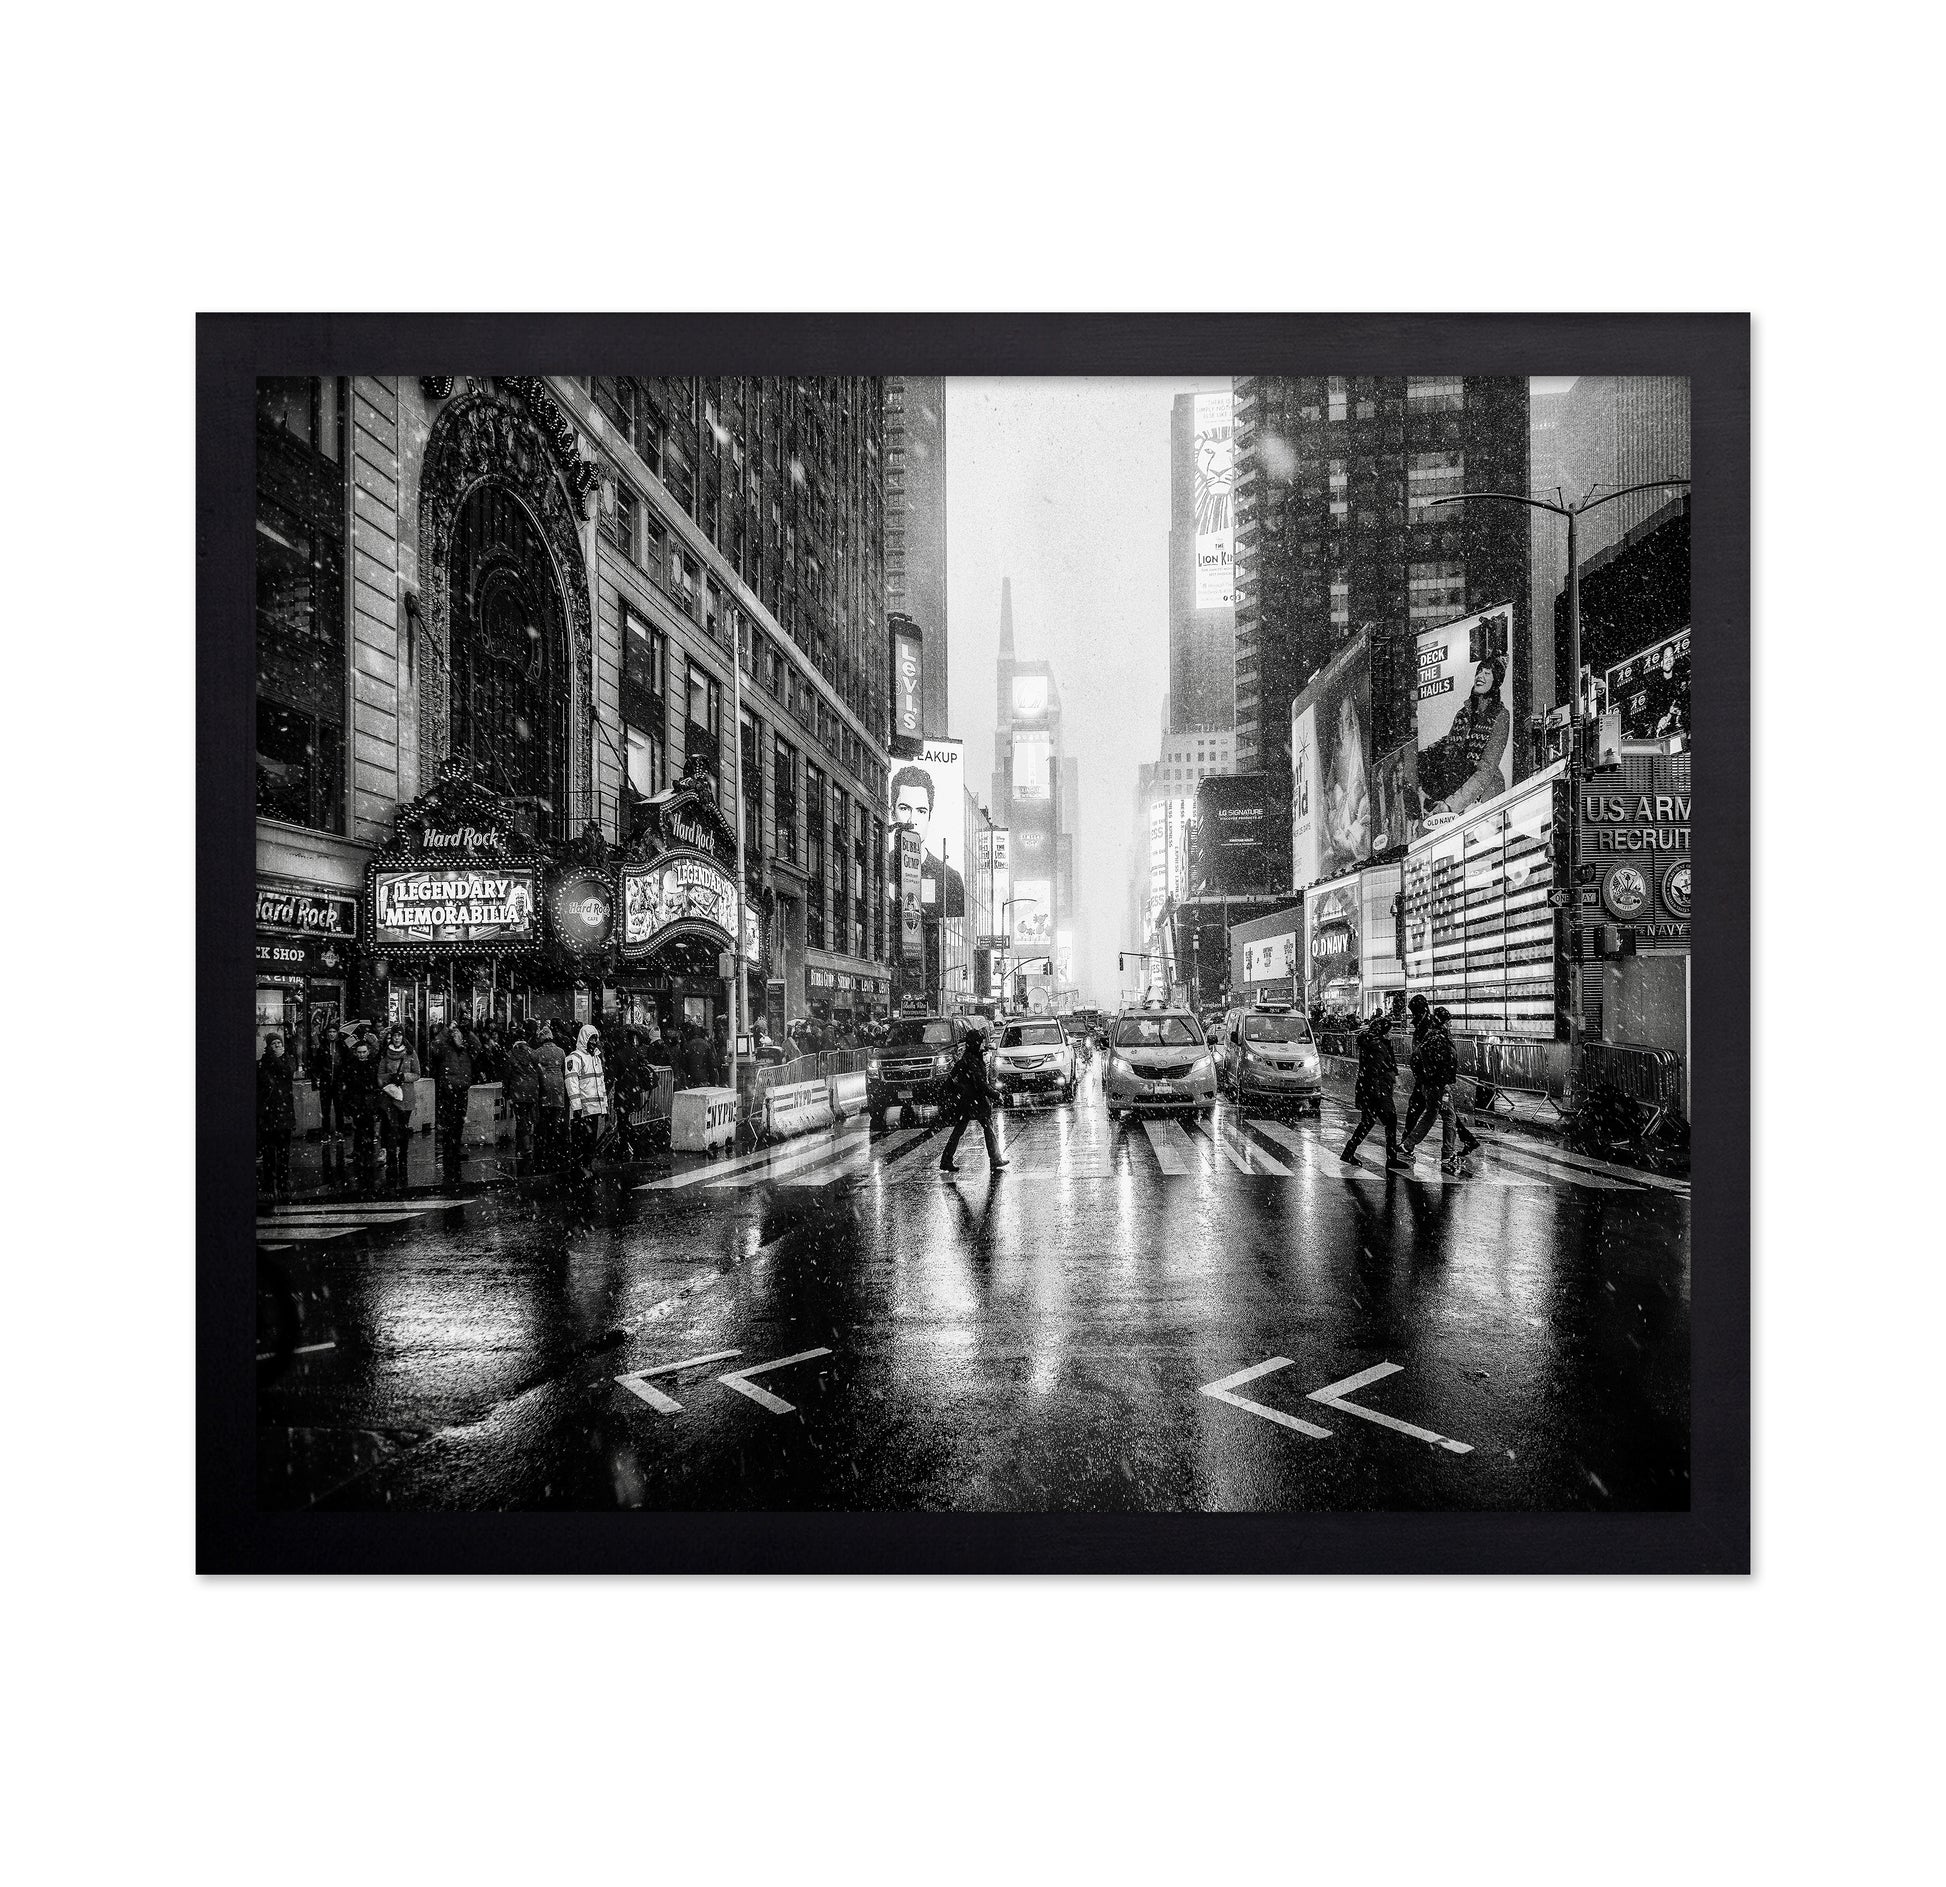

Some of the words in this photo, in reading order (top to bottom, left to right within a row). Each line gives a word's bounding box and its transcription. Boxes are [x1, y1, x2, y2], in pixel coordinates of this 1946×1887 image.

[1198, 553, 1219, 567] LION
[1420, 648, 1446, 667] DECK
[1420, 667, 1438, 682] THE
[1420, 680, 1450, 699] HAULS
[1427, 818, 1439, 827] OLD
[1439, 815, 1456, 825] NAVY
[423, 827, 463, 847] Hard
[463, 827, 499, 850] Rock
[673, 813, 696, 843] Hard
[697, 824, 715, 855] Rock
[903, 854, 920, 870] GUMP
[397, 879, 509, 901] LEGENDARY
[1556, 894, 1569, 903] ONE
[297, 898, 338, 932] Rock
[385, 905, 520, 927] MEMORABILIA
[569, 901, 592, 914] Hard
[593, 902, 610, 918] Rock
[1647, 924, 1684, 936] NAVY
[1327, 933, 1349, 955] NAVY
[273, 948, 305, 962] SHOP
[710, 1101, 733, 1128] NYPD
